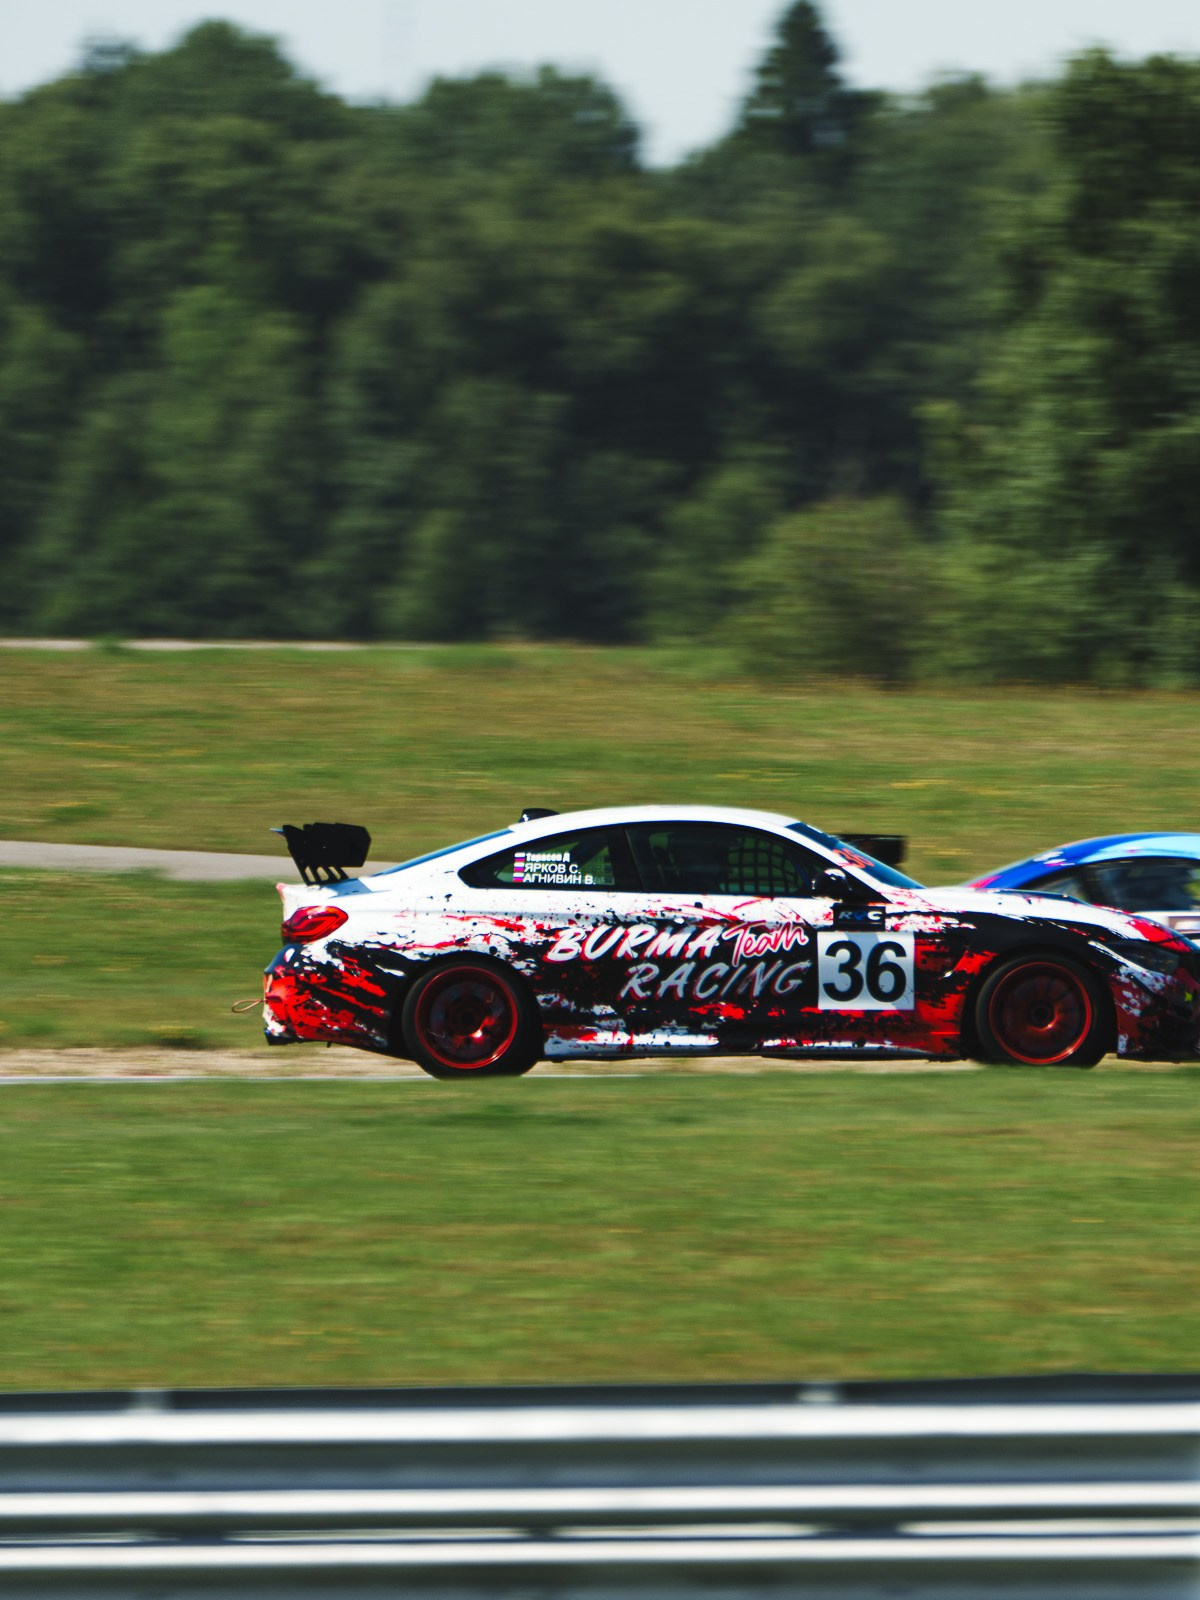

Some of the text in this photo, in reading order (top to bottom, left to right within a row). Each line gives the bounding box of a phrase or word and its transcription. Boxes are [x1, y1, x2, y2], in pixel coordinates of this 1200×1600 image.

[523, 874, 596, 885] АГНИВИН В.
[524, 863, 566, 873] ЯРКОВ
[544, 919, 810, 967] BURMA Team
[619, 960, 812, 1000] RACING
[823, 939, 907, 1002] 36
